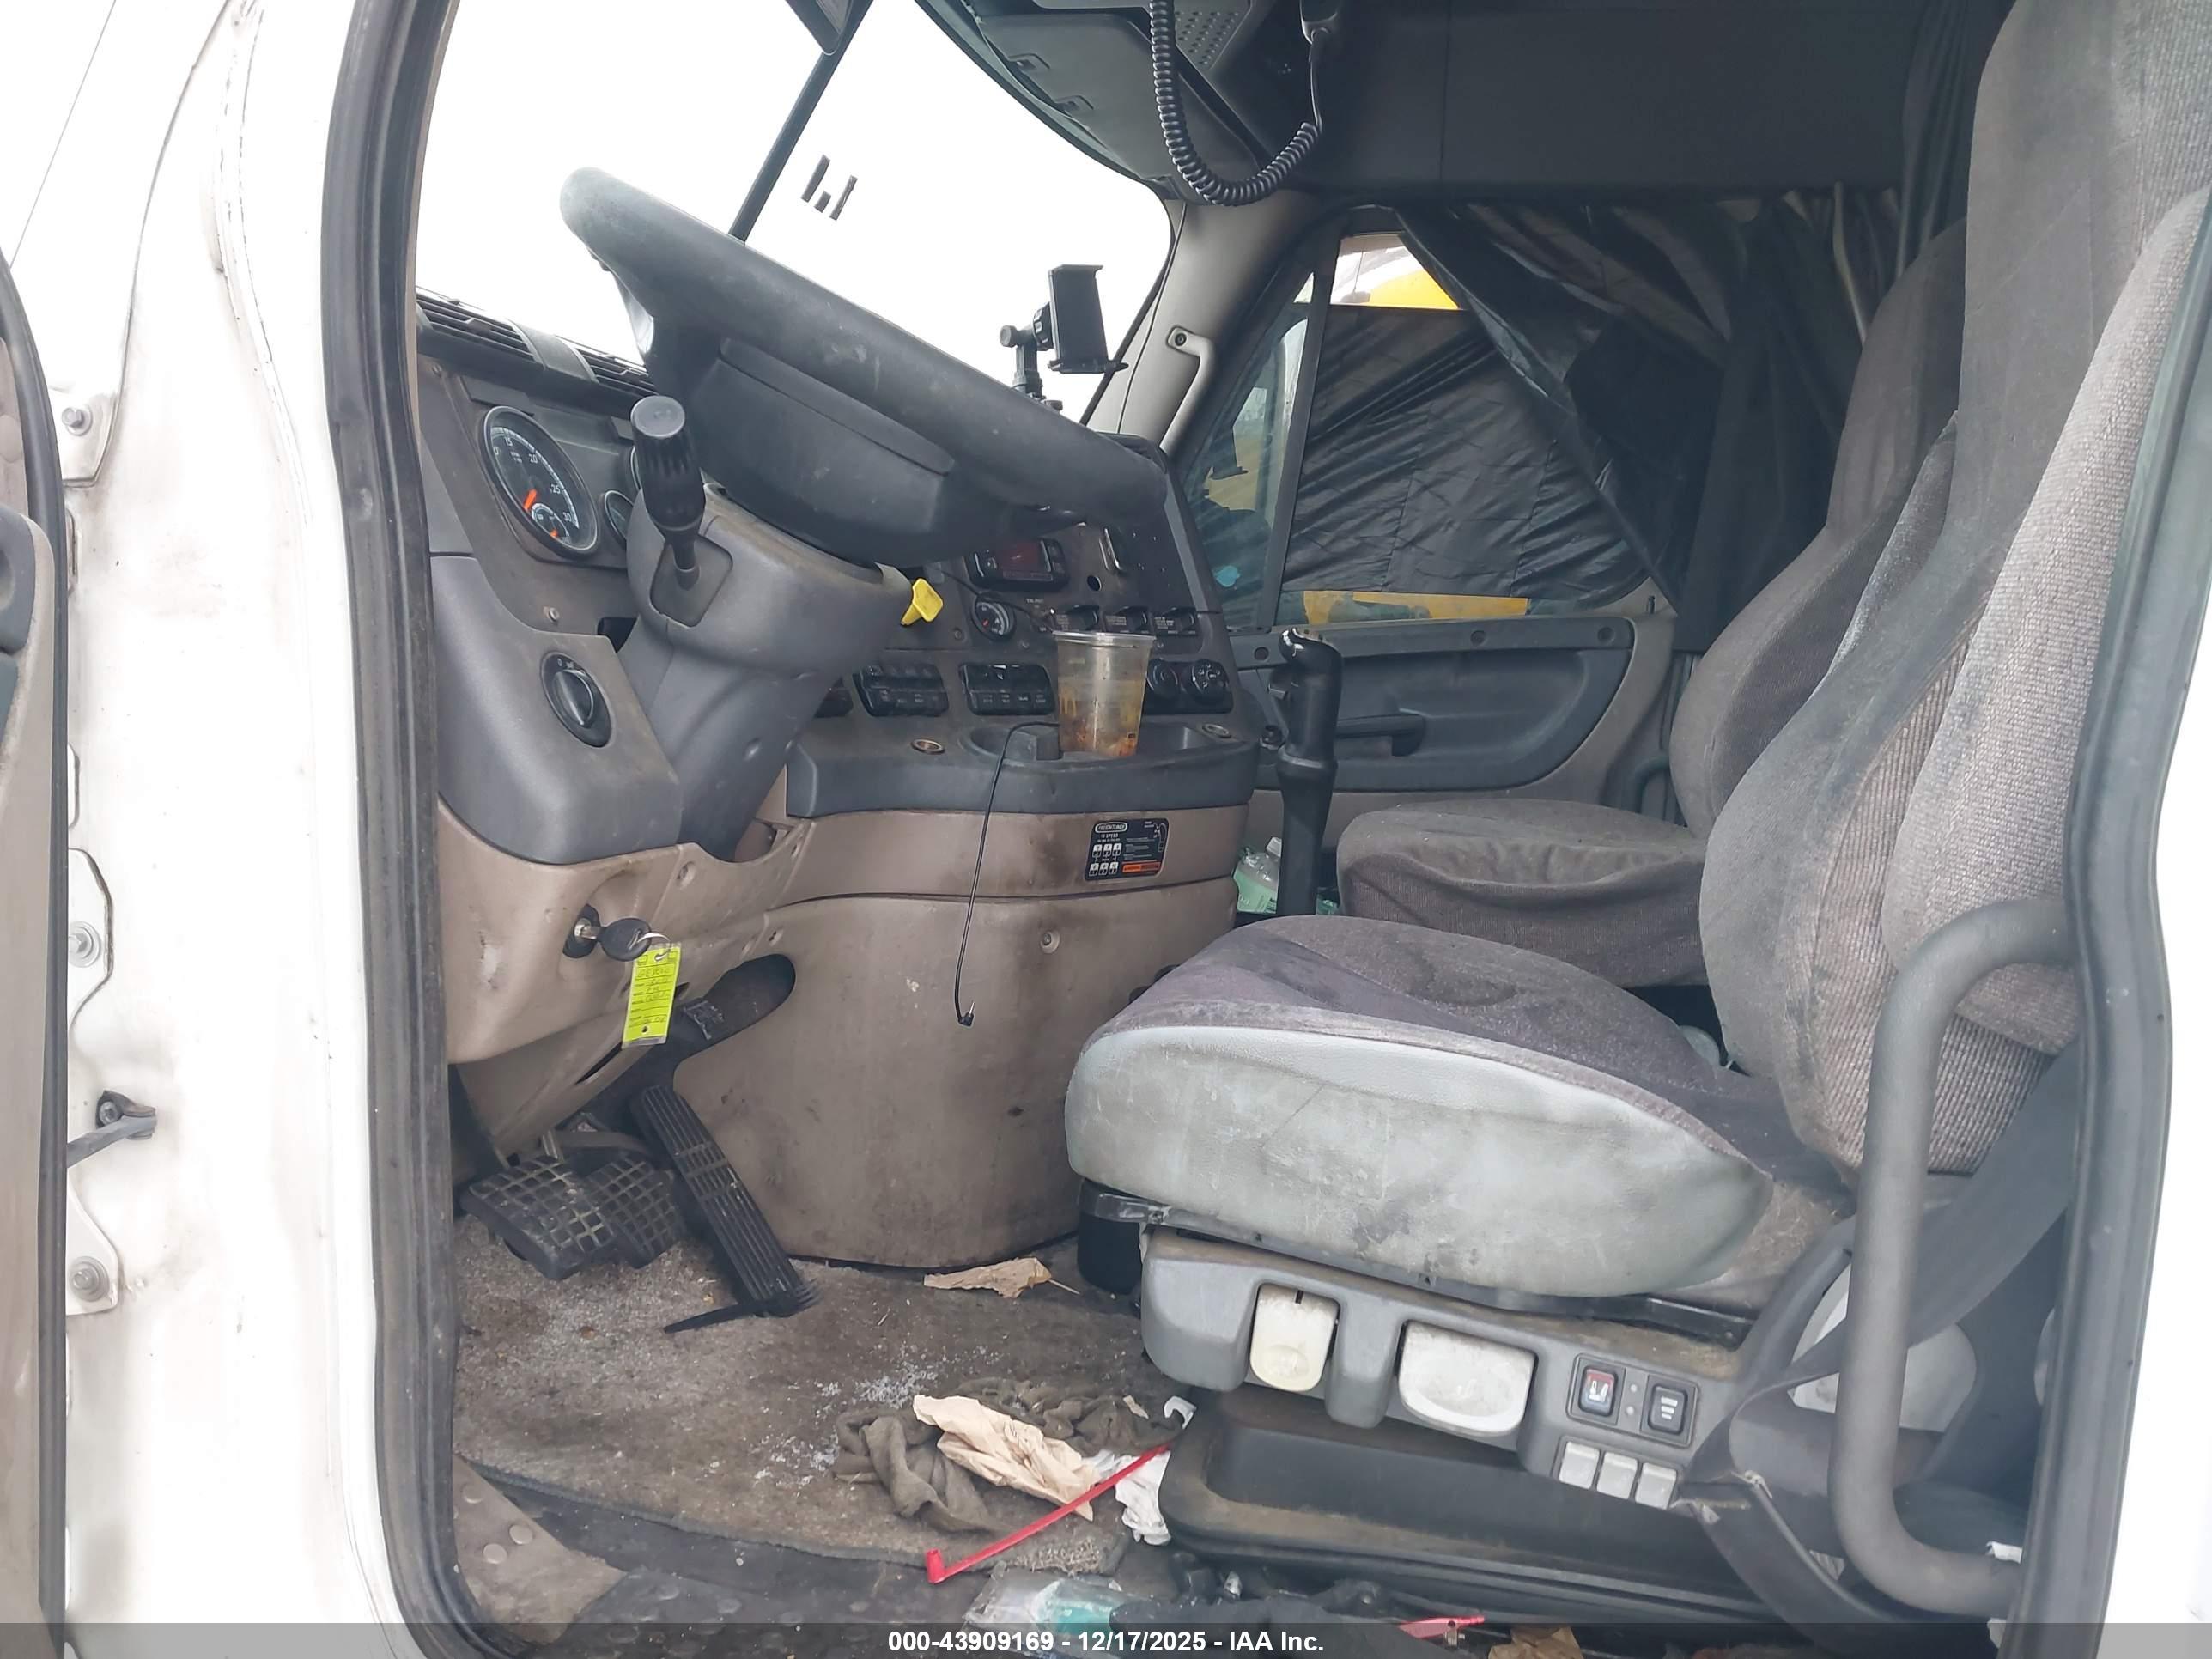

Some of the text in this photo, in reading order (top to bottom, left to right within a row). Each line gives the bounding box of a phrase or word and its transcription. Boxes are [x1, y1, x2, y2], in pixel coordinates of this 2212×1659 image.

[528, 453, 538, 464] 20
[550, 484, 561, 494] 25
[562, 512, 572, 522] 30
